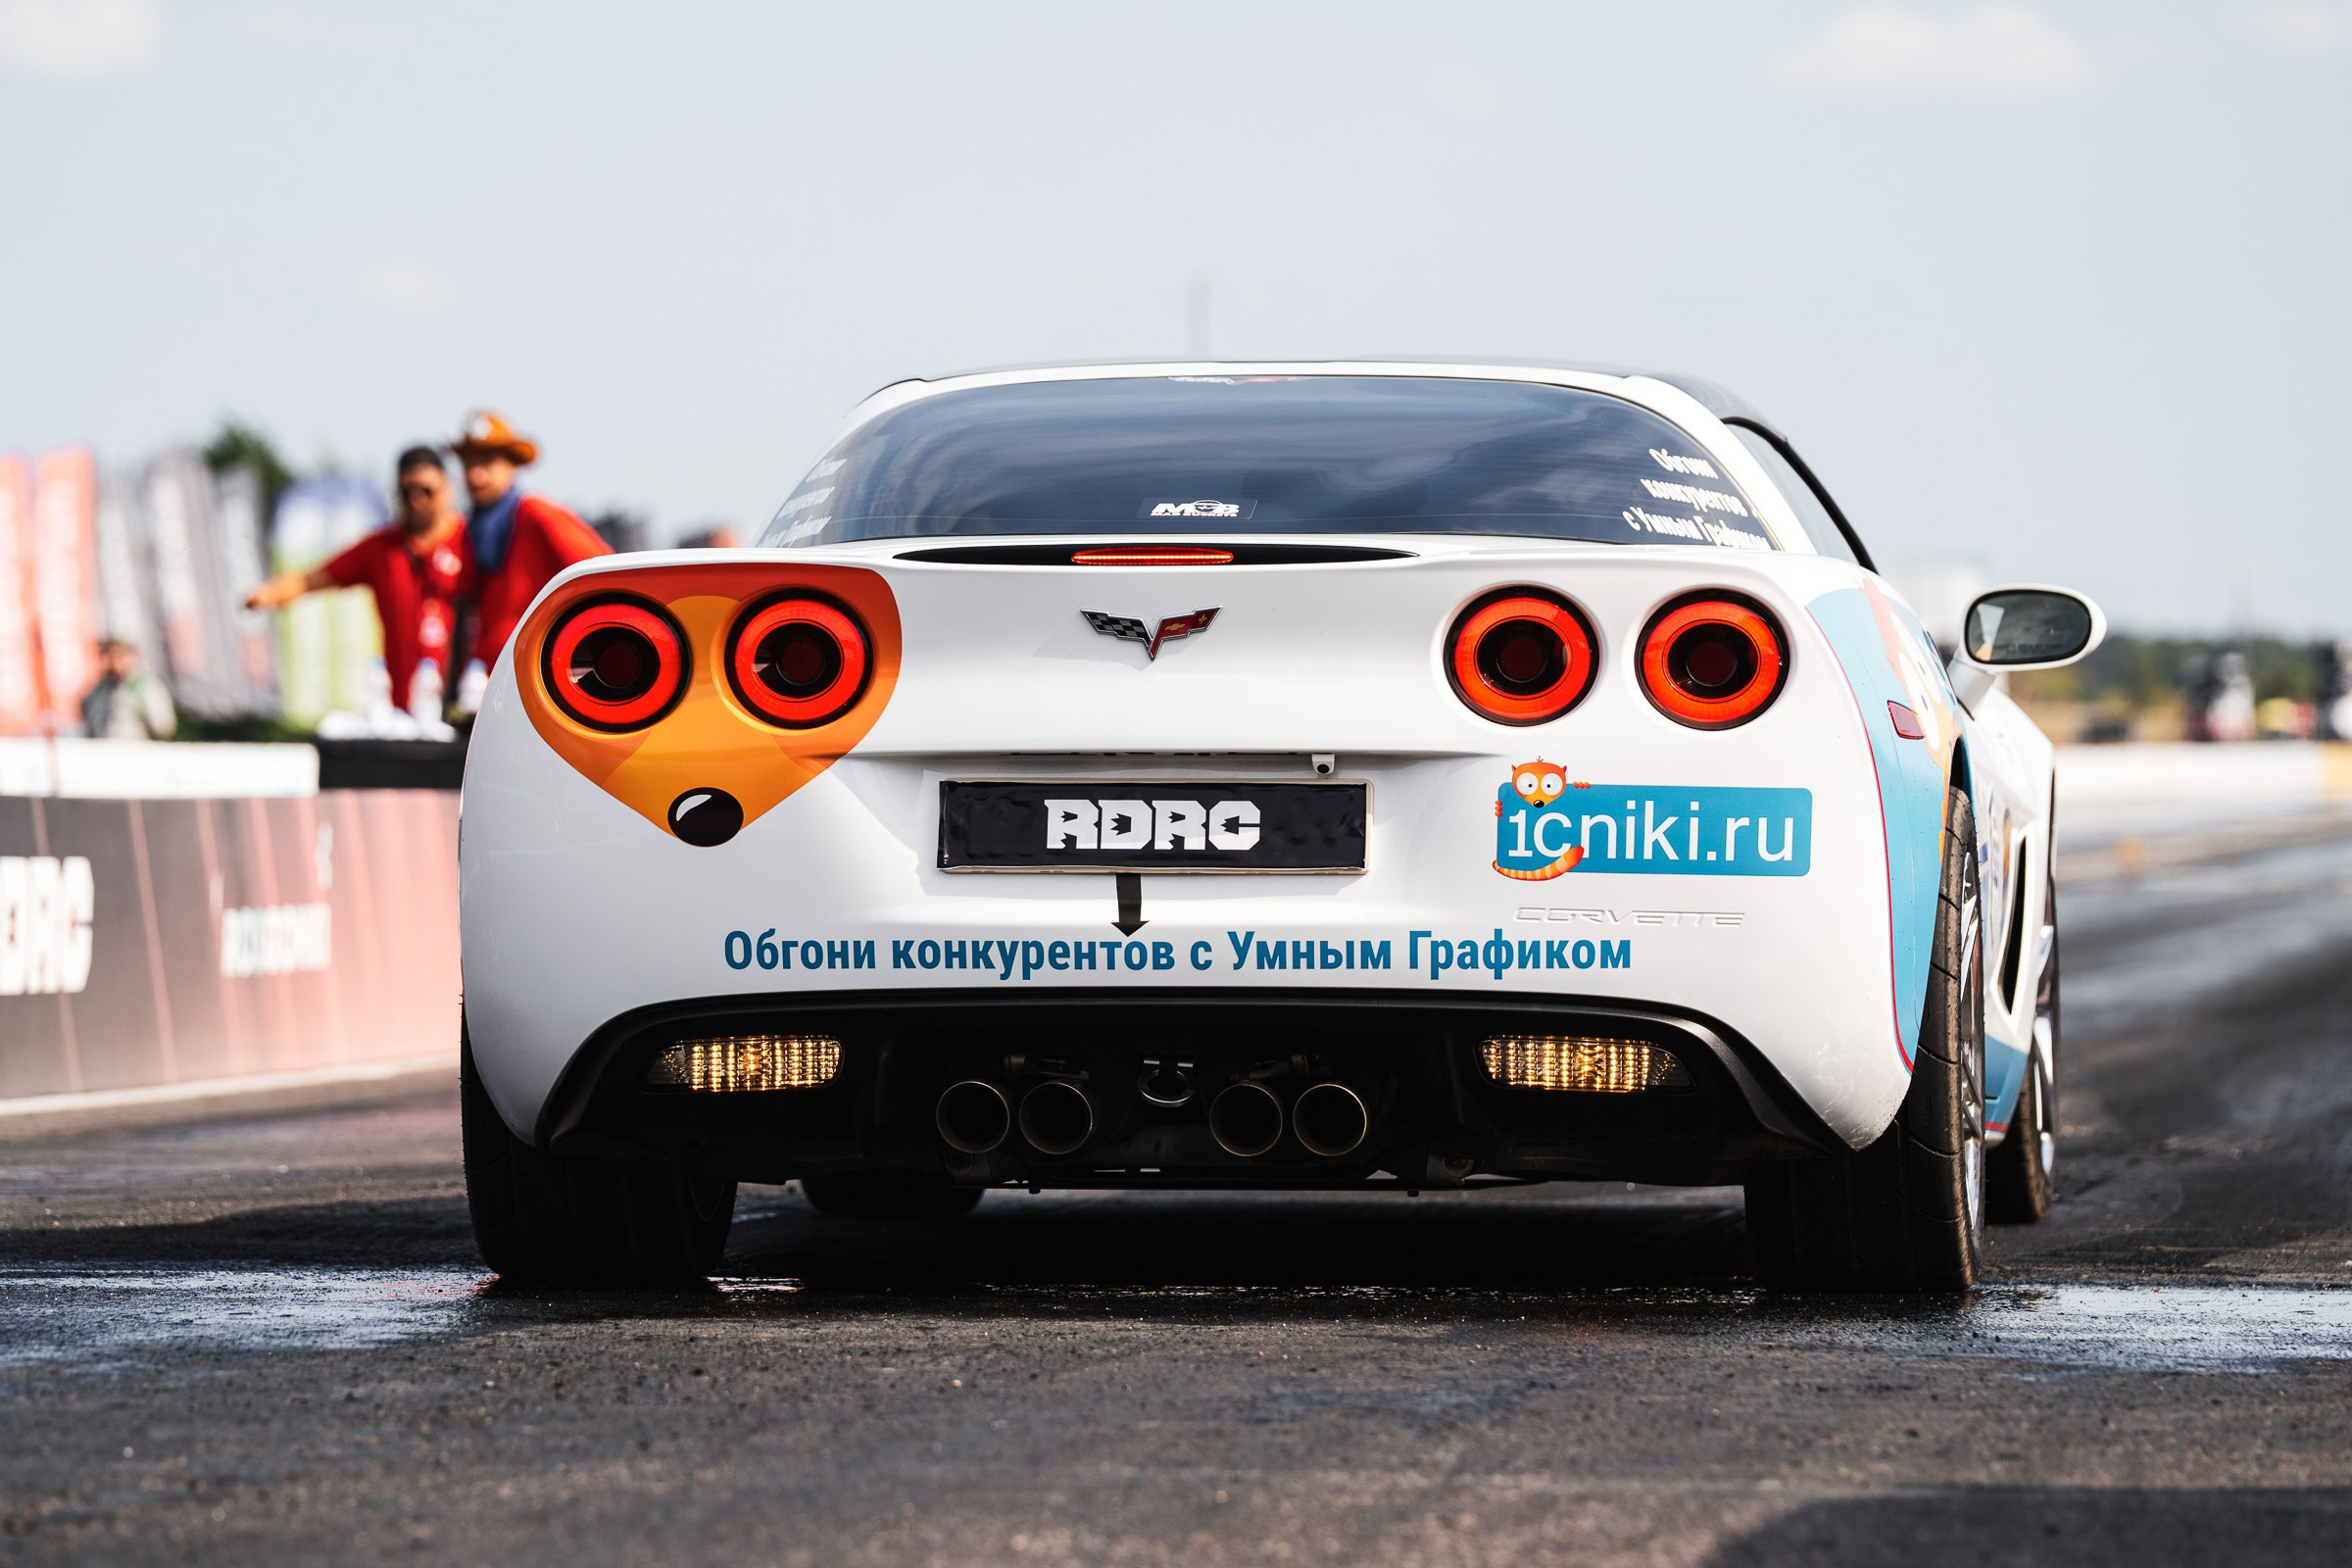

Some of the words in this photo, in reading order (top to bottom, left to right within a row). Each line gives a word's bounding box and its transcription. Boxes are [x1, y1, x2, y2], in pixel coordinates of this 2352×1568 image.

[1044, 799, 1261, 851] RDRC
[1507, 800, 1794, 862] 1cniki.ru
[0, 856, 95, 996] DRC
[1512, 906, 1746, 927] CORVETTE
[724, 927, 876, 970] Обгони
[892, 938, 1176, 981] конкурентов
[1190, 941, 1213, 971] с
[1227, 931, 1392, 970] Умным
[1408, 928, 1632, 981] Графиком
